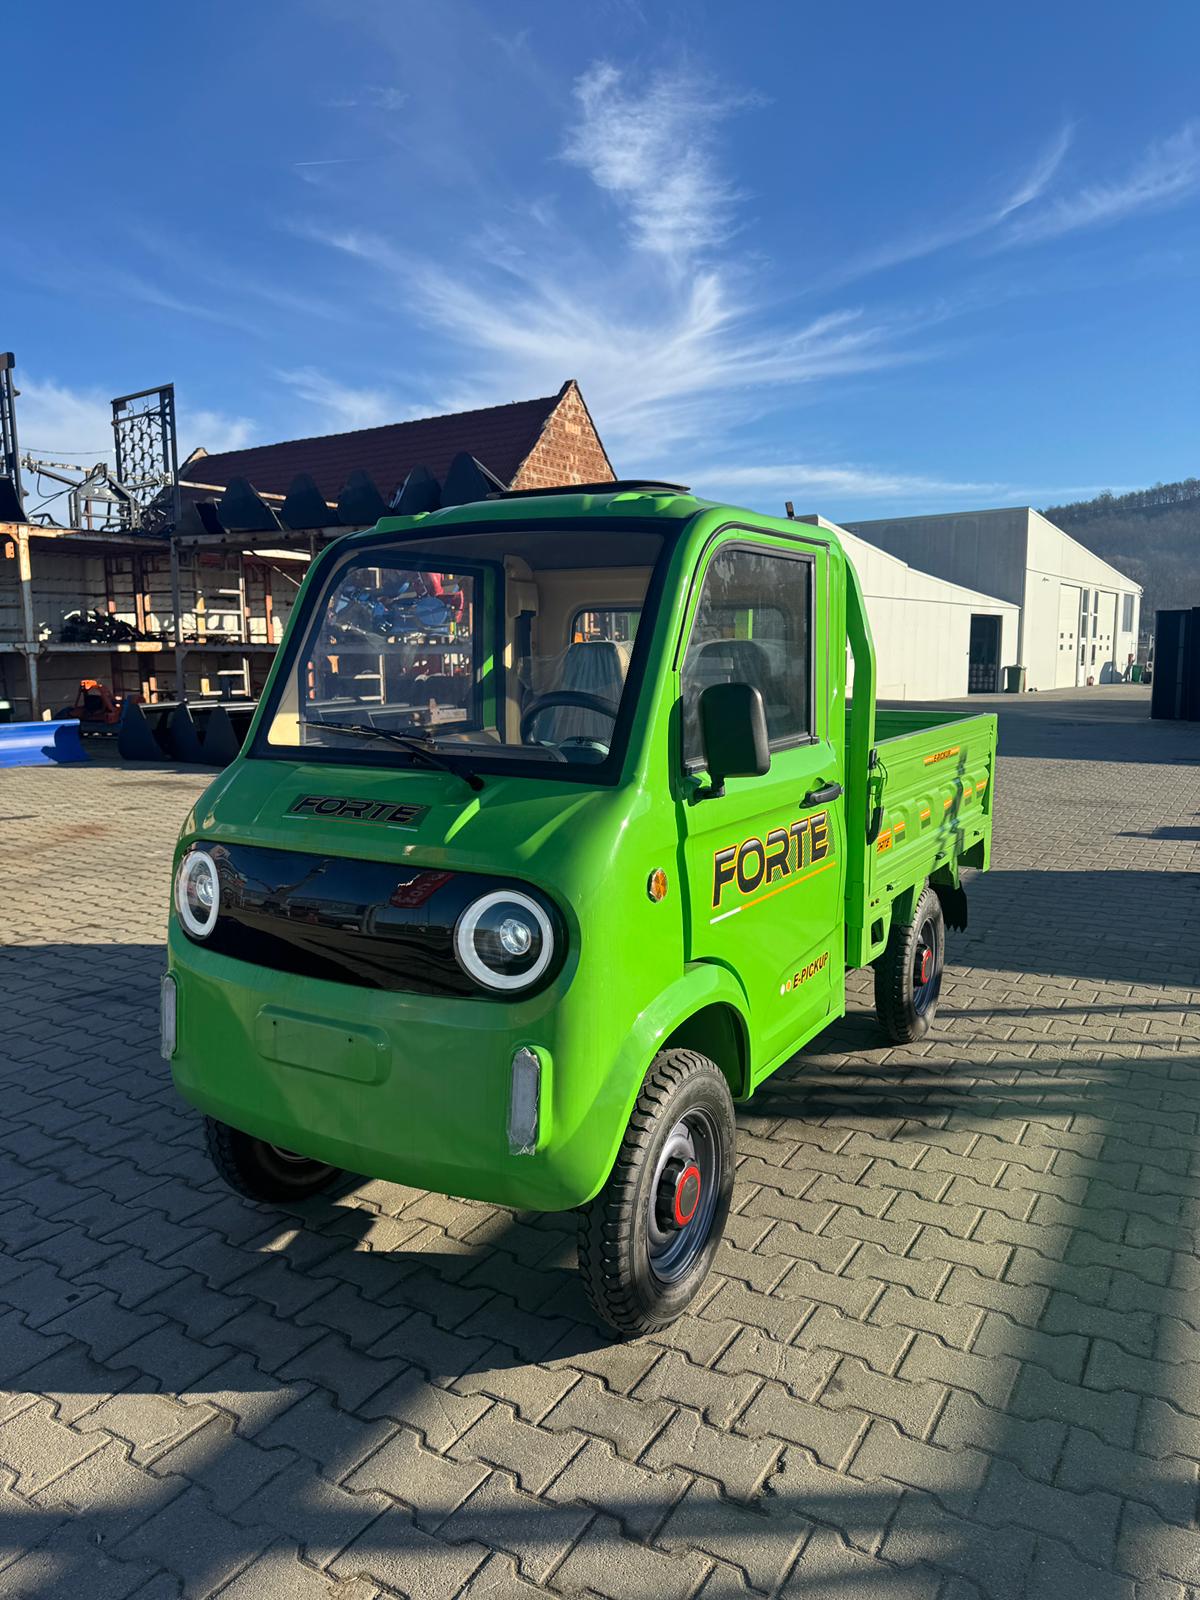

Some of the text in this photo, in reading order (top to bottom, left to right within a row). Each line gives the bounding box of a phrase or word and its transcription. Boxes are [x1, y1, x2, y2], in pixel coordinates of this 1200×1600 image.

[291, 795, 421, 823] FORTE
[712, 809, 828, 909] FORTE
[792, 951, 829, 989] E-PICKUP
